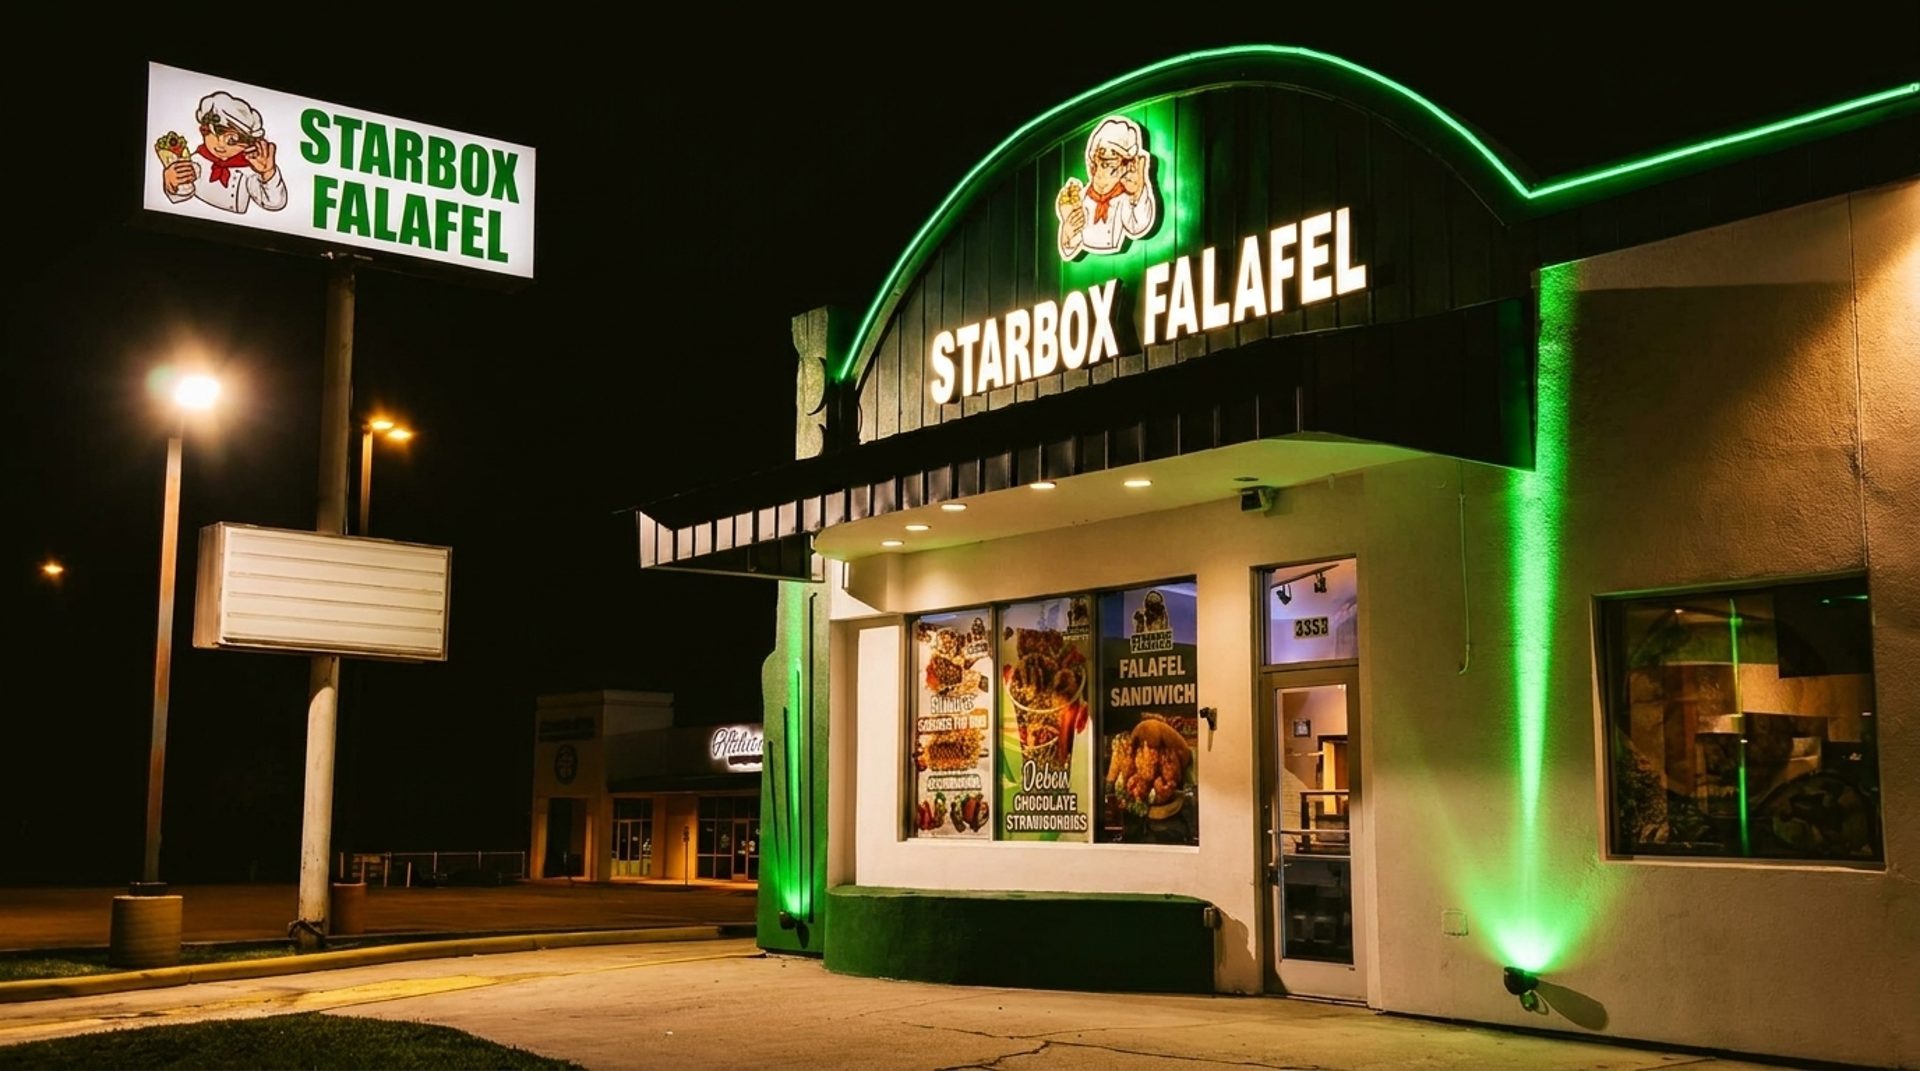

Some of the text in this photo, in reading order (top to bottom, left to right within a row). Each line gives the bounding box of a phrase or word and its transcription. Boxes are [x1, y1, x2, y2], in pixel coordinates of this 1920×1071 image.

[300, 108, 520, 204] STARBOX
[312, 174, 509, 263] FALAFEL
[930, 207, 1367, 405] STARBOX FALAFEL
[1111, 683, 1196, 707] SANDWICH
[1120, 655, 1186, 679] FALAFEL
